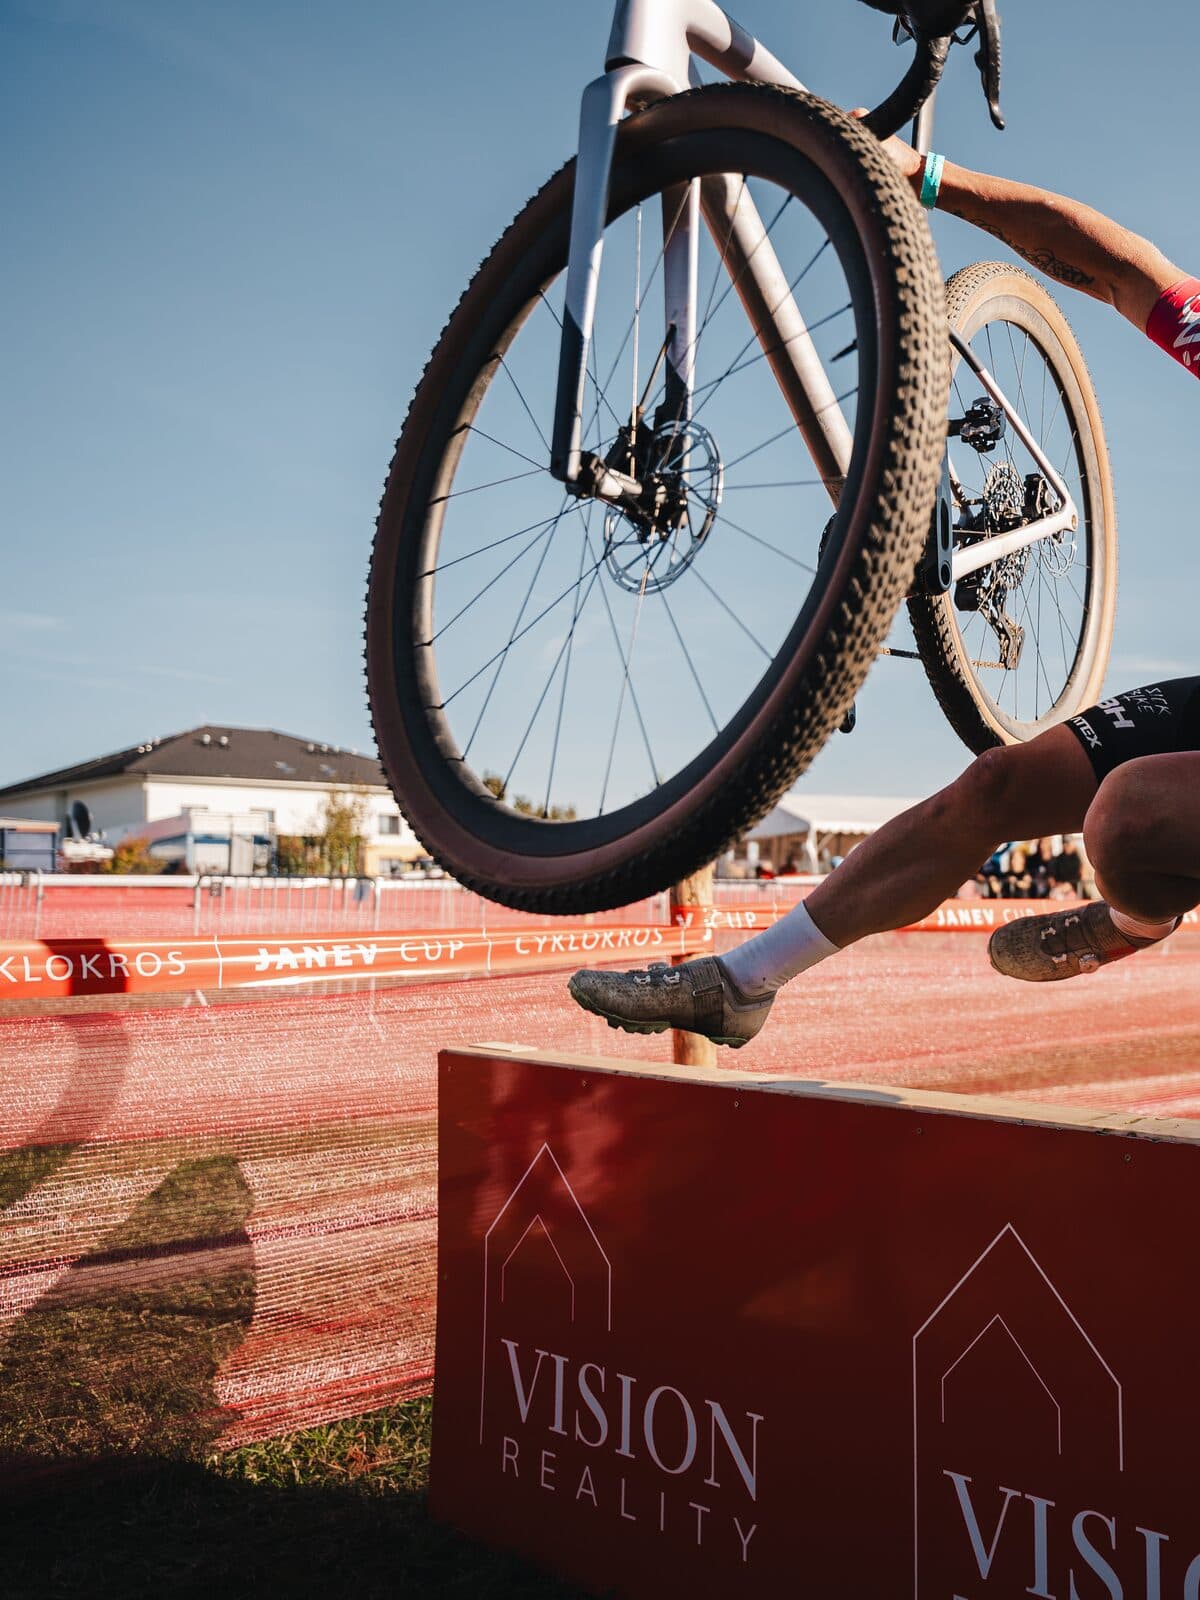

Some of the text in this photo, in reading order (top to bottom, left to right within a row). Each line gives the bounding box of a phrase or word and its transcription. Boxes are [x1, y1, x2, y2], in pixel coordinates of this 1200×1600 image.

[255, 941, 377, 971] JANEV
[400, 940, 465, 962] CUP
[937, 908, 994, 927] JANEV
[501, 1338, 764, 1501] VISION
[502, 1436, 757, 1562] REALITY
